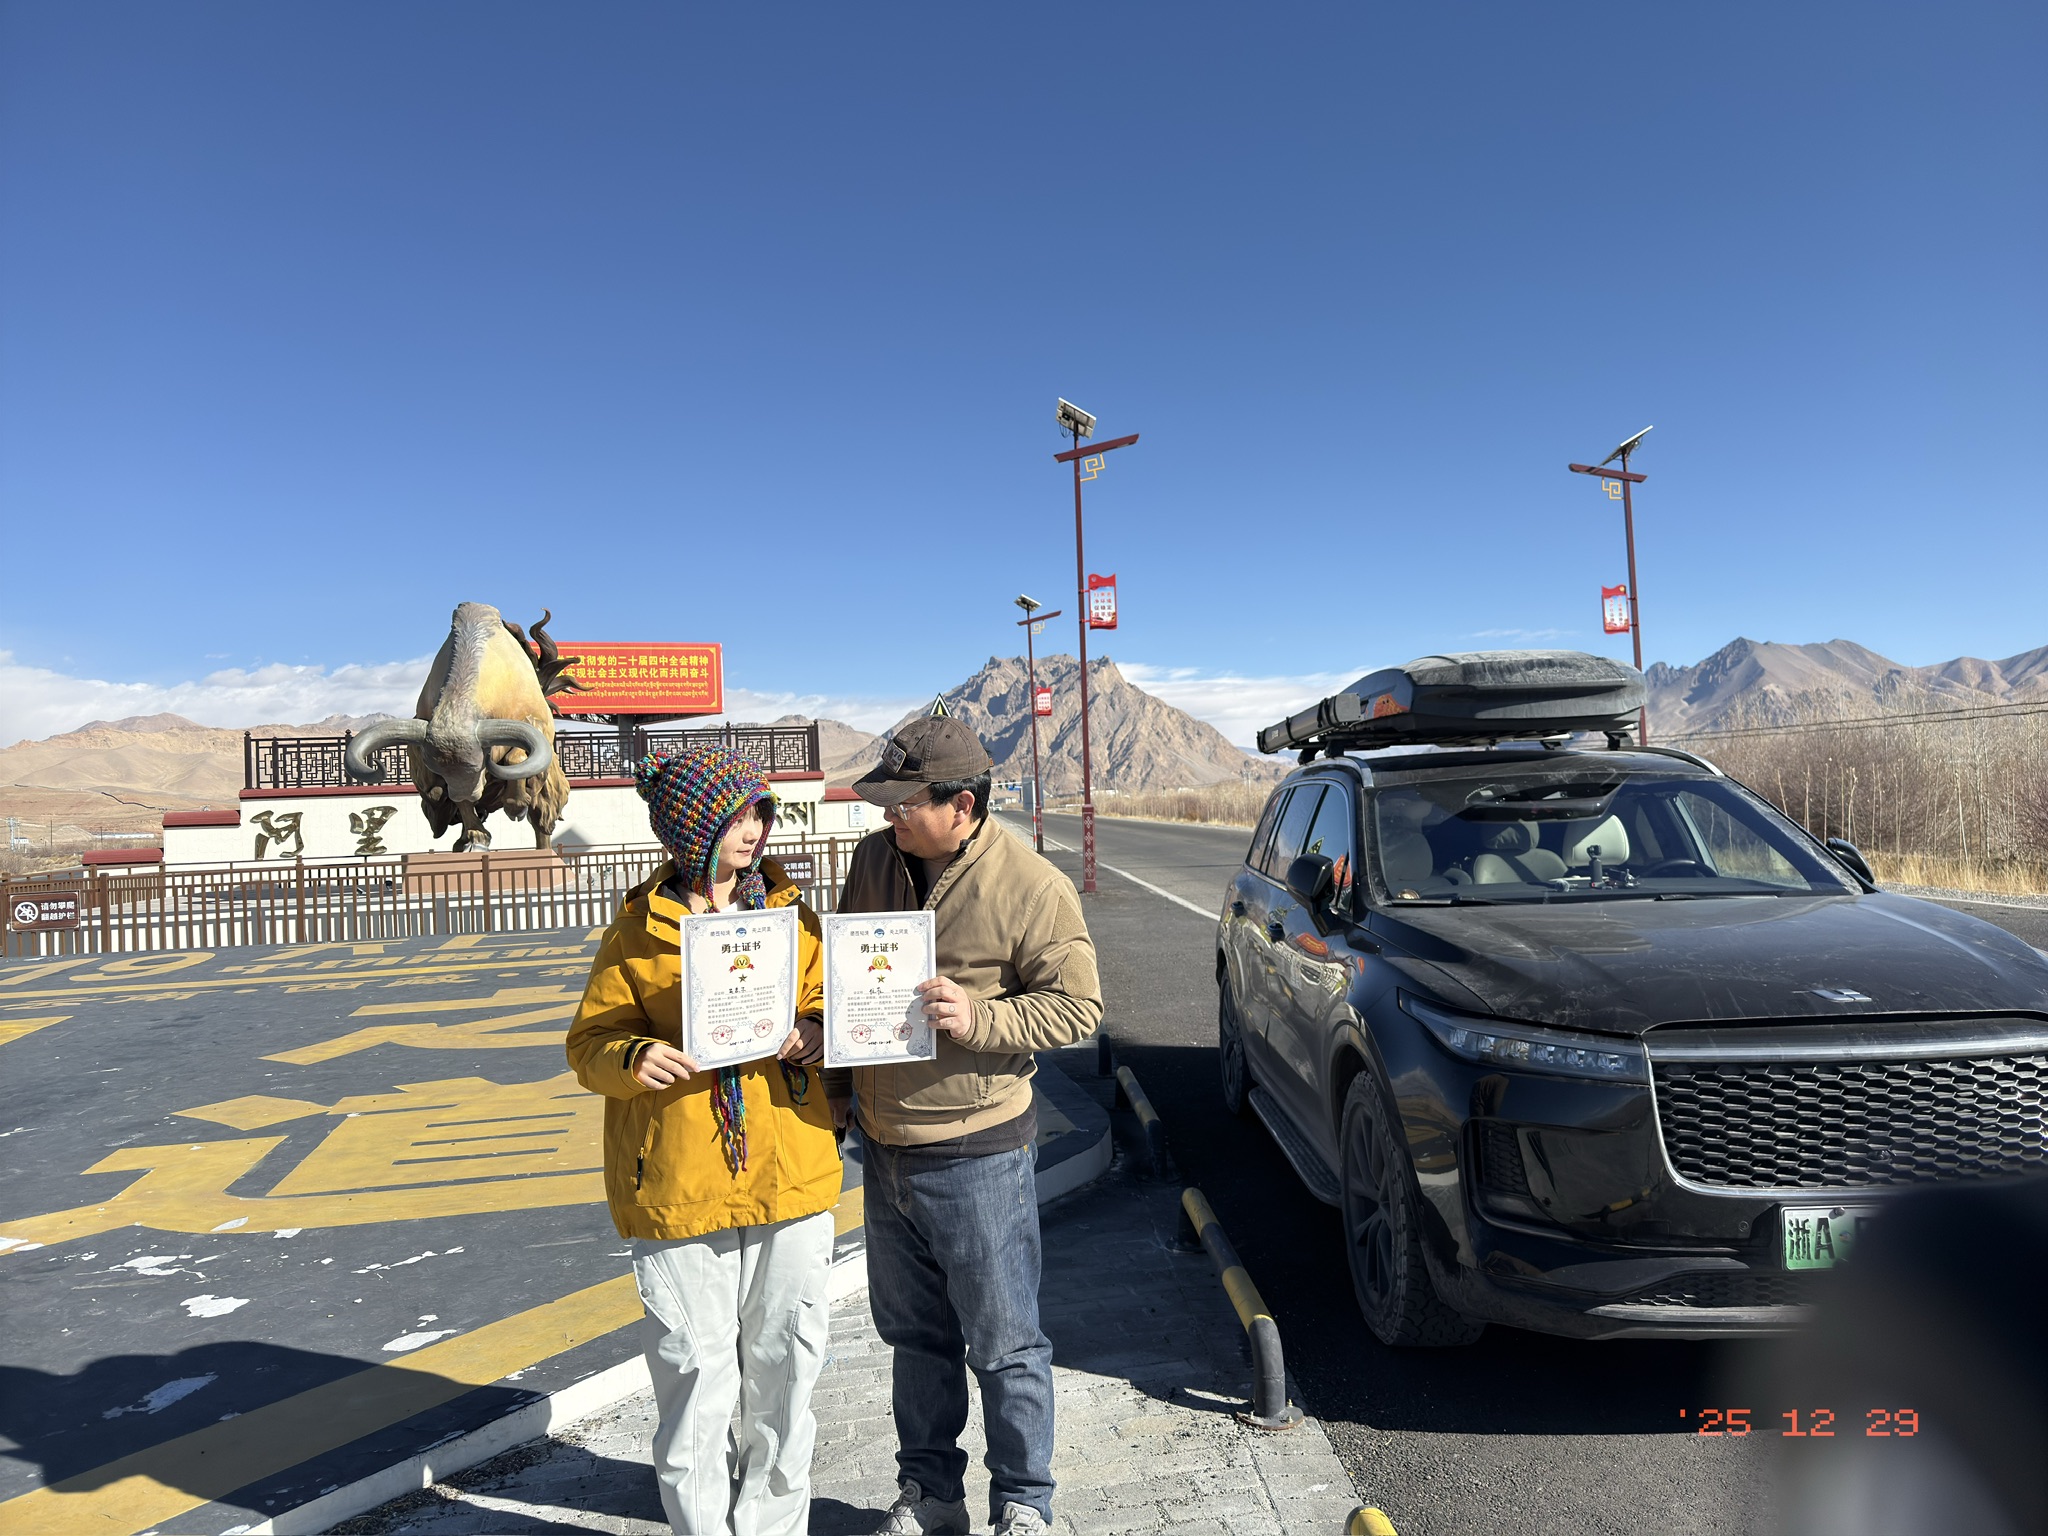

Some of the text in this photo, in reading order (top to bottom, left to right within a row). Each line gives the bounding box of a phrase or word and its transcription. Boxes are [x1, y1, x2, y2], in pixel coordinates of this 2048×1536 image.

[41, 912, 76, 921] 翻越护栏
[721, 941, 761, 954] 勇士证书
[860, 942, 899, 954] 勇士证书
